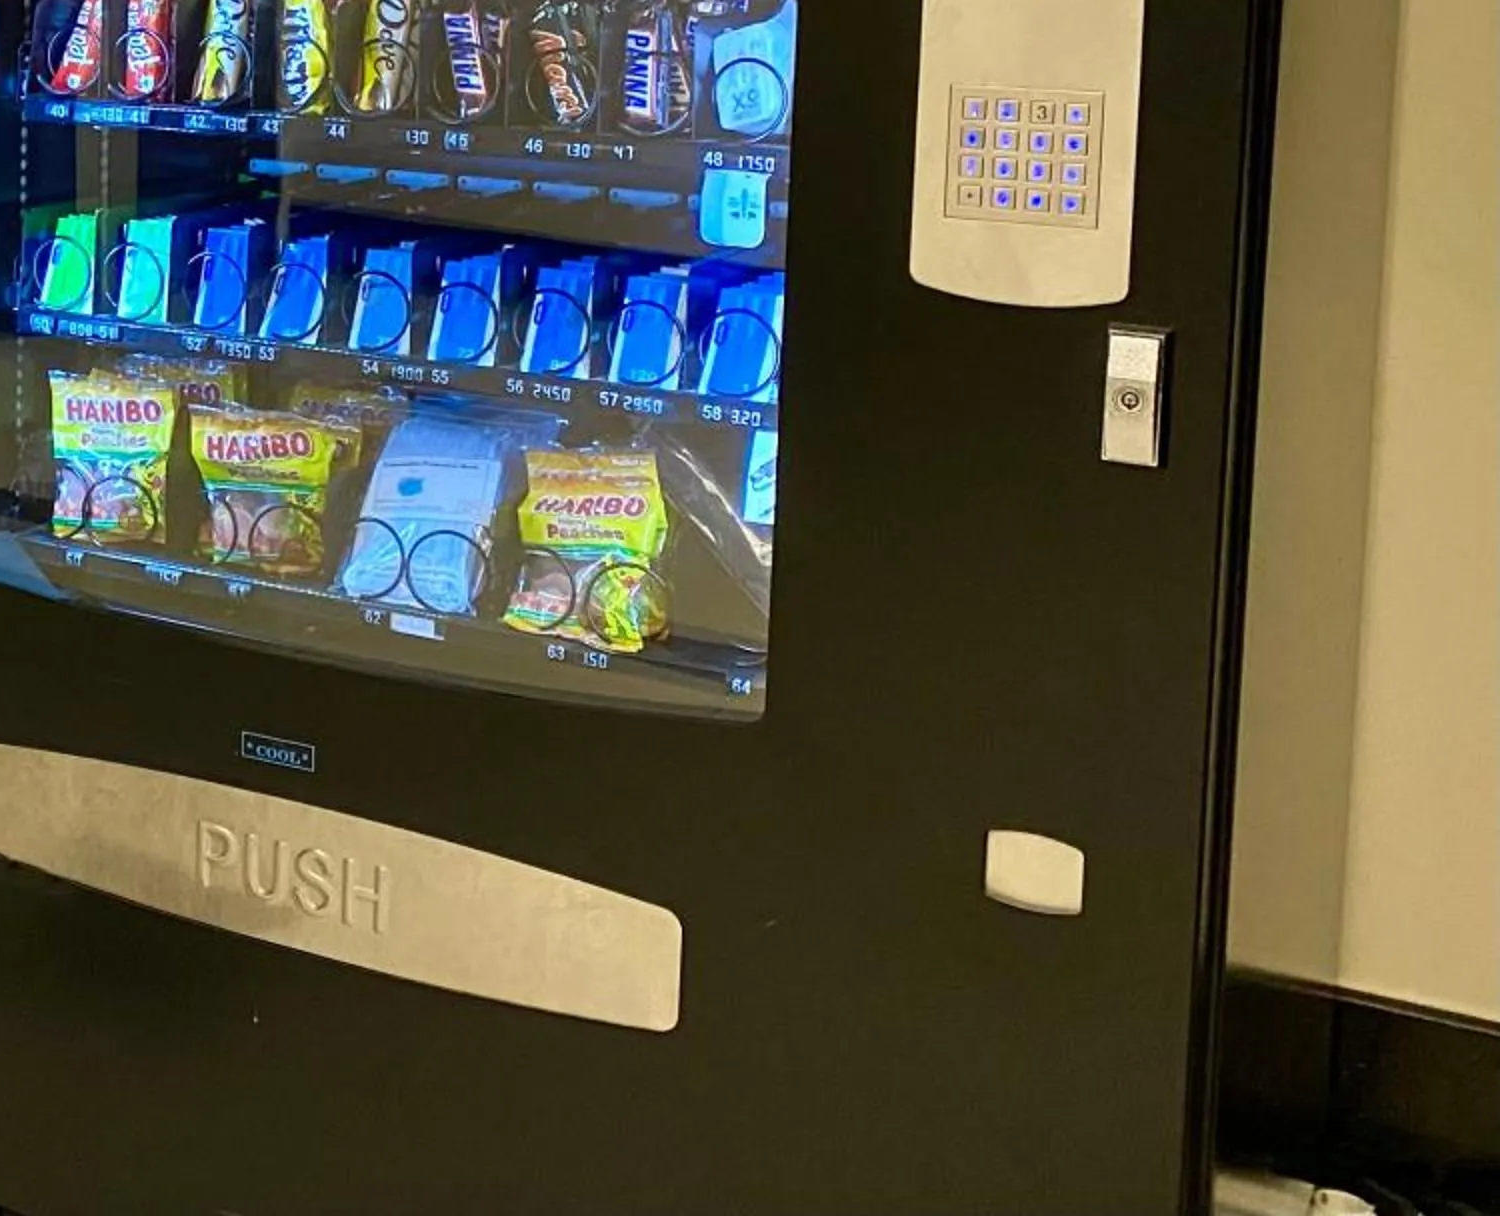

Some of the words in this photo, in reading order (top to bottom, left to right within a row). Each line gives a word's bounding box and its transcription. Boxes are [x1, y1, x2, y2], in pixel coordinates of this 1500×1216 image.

[624, 33, 650, 109] PANNA
[1036, 104, 1048, 121] 3
[262, 119, 279, 133] 43
[328, 124, 345, 139] 44
[524, 138, 543, 154] 46
[703, 151, 724, 168] 48
[186, 336, 202, 351] 52
[258, 345, 276, 361] 53
[362, 360, 379, 375] 54
[431, 368, 449, 385] 55
[505, 378, 524, 394] 56
[599, 391, 619, 408] 57
[65, 398, 163, 424] HARIBO
[702, 404, 722, 422] 58
[206, 431, 313, 462] HARIBO
[533, 495, 647, 517] HARIBO
[255, 743, 301, 765] COOL
[197, 819, 391, 934] PUSH
